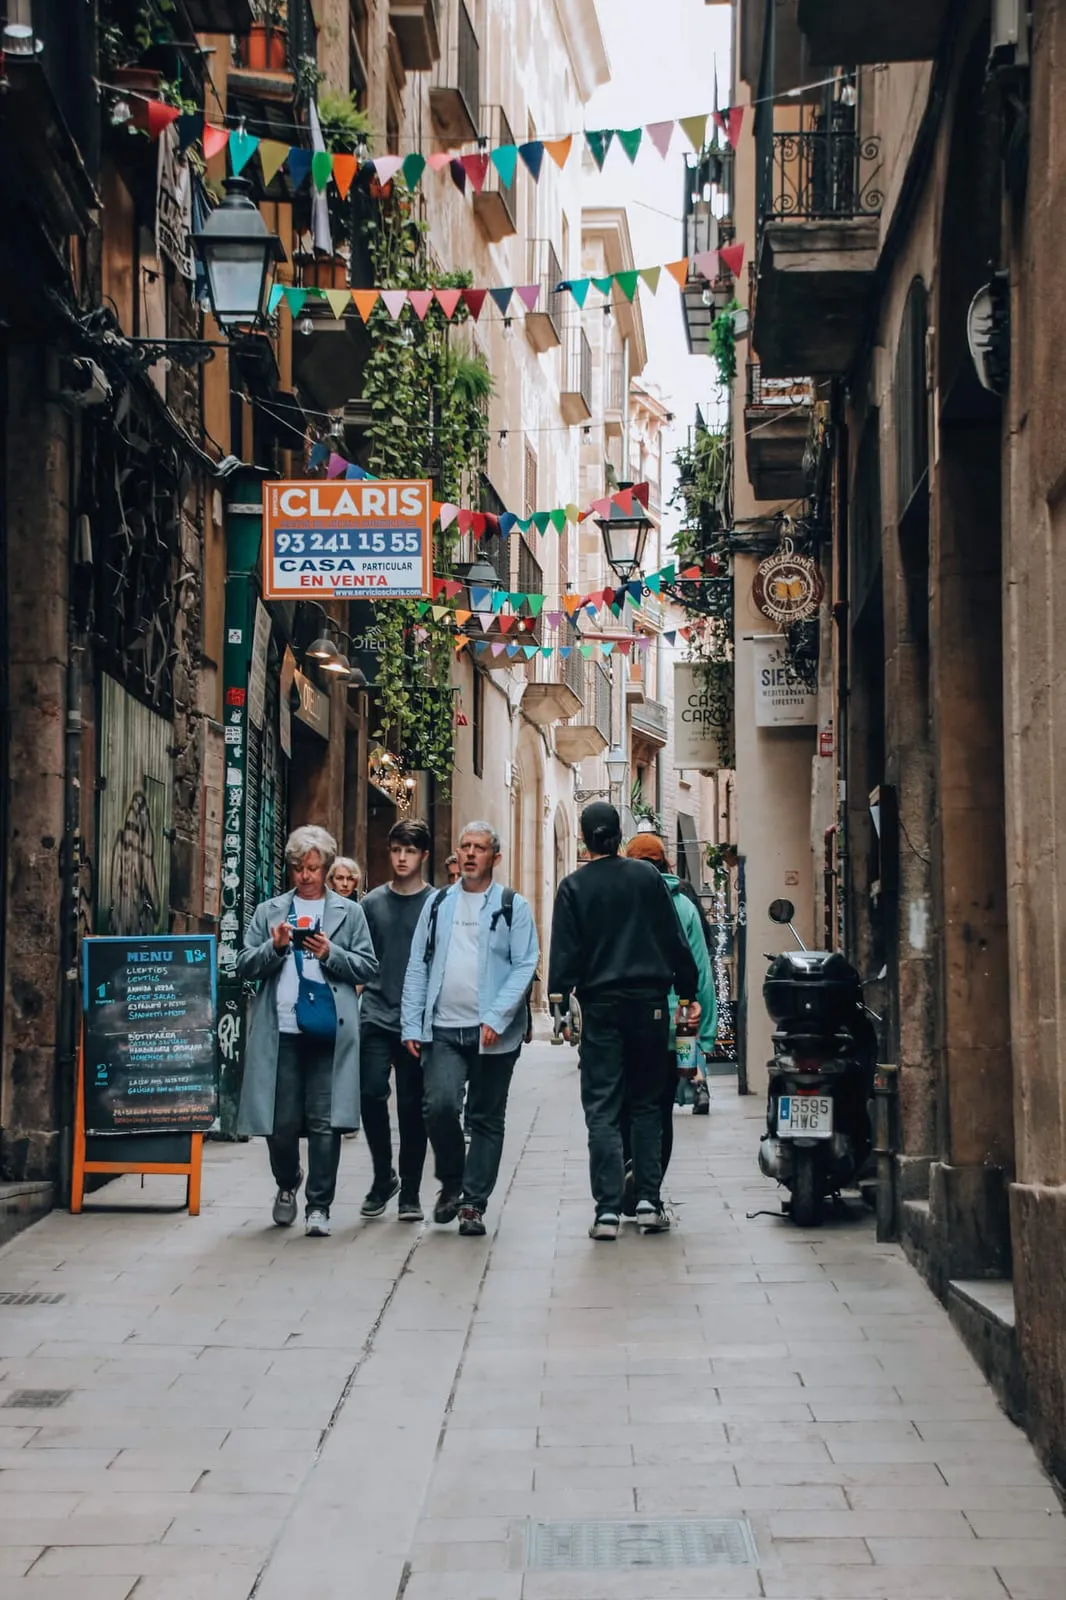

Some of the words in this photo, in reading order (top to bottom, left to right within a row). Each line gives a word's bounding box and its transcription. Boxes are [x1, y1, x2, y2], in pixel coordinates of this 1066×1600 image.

[280, 488, 423, 517] CLARIS
[276, 533, 305, 552] 93
[310, 533, 352, 552] 241
[358, 533, 386, 552] 15
[391, 533, 419, 552] 55
[279, 559, 355, 571] CASA
[362, 562, 413, 571] PARTICULAR
[759, 555, 812, 576] BARCELONA
[300, 575, 323, 586] EN
[329, 575, 388, 586] VENTA
[127, 951, 173, 962] MENU
[791, 1098, 829, 1114] 5595
[790, 1115, 819, 1129] HWG
